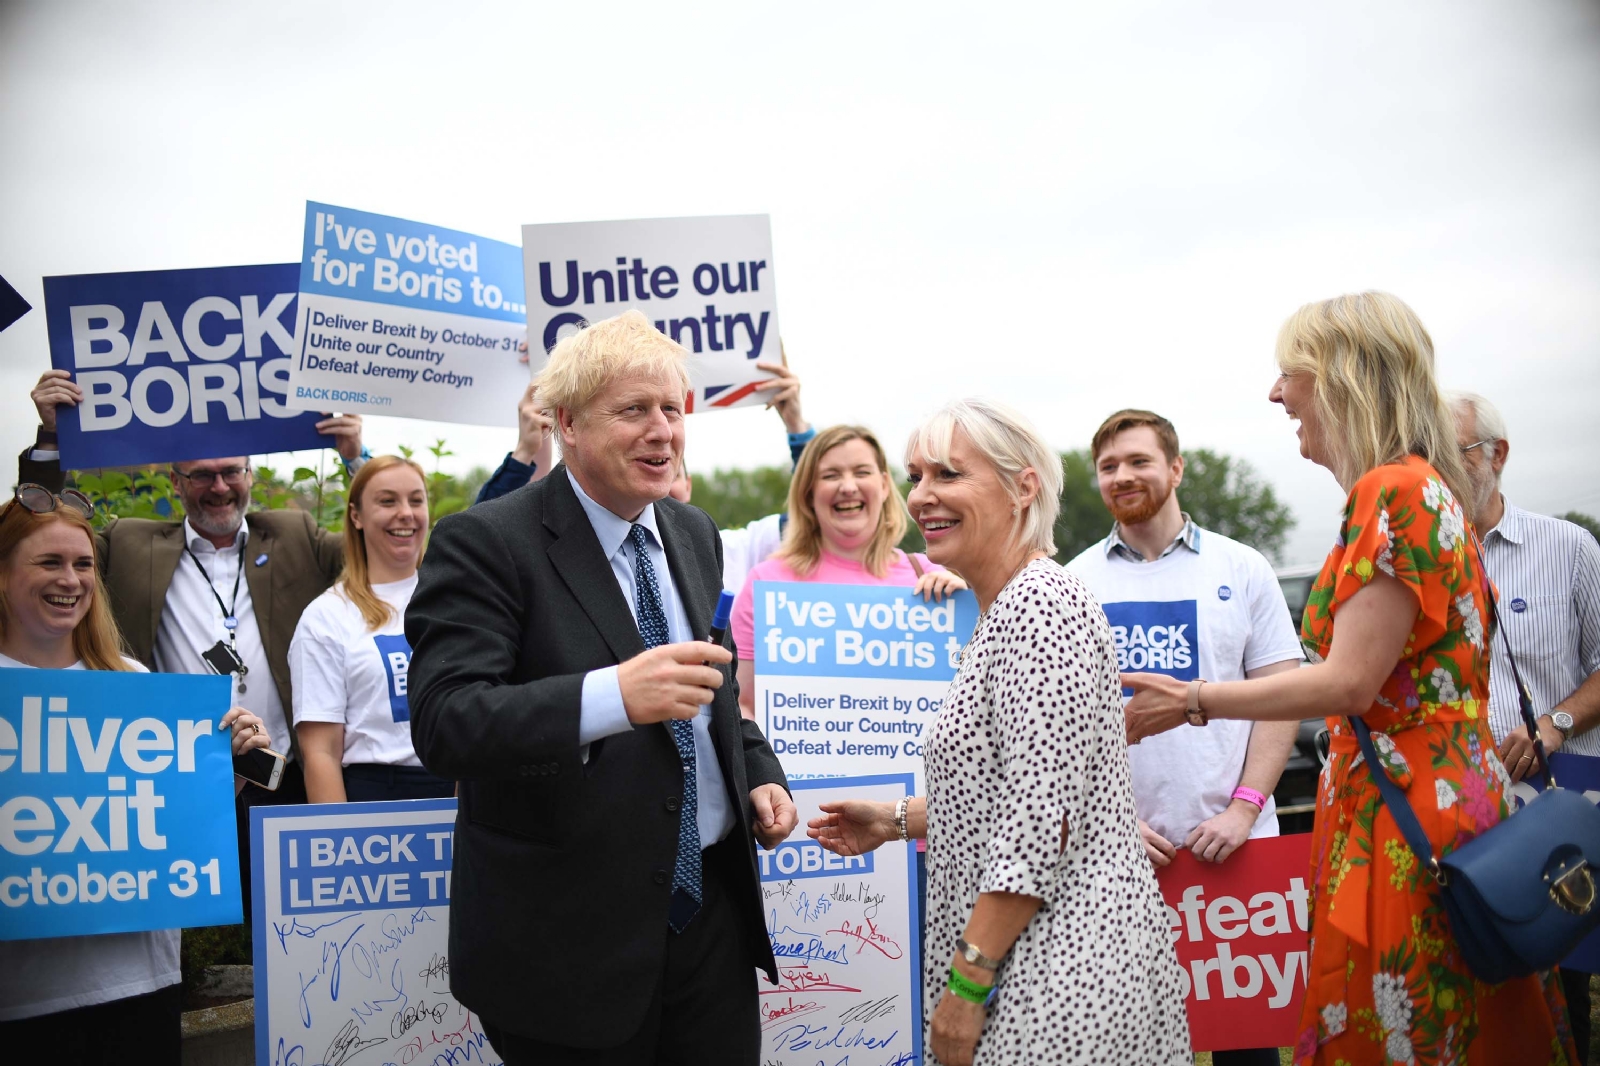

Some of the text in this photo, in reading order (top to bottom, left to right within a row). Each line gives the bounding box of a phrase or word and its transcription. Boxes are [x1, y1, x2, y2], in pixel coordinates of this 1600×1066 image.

[315, 212, 478, 272] I've voted
[311, 249, 526, 314] for Boris to...
[539, 257, 766, 307] Unite our
[70, 293, 297, 368] BACK
[312, 311, 368, 332] Deliver
[372, 319, 416, 338] Brexit
[420, 326, 438, 343] by
[442, 329, 499, 348] October
[310, 333, 444, 365] Unite our Country
[307, 355, 473, 388] Defeat Jeremy Corbyn
[76, 358, 304, 431] BORIS
[765, 591, 955, 633] I've voted
[764, 628, 824, 663] for
[836, 630, 935, 668] Boris
[1111, 624, 1190, 649] BACK
[1116, 647, 1192, 669] BORIS
[773, 693, 835, 709] Deliver
[840, 694, 888, 711] Brexit
[893, 696, 912, 715] by
[773, 716, 923, 737] Unite our Country
[773, 739, 831, 755] Defeat
[837, 740, 898, 759] Jeremy
[0, 776, 166, 855] exit
[289, 831, 454, 868] I BACK T
[169, 858, 221, 897] 31
[290, 870, 452, 908] LEAVE T
[1177, 942, 1308, 1009] rby
